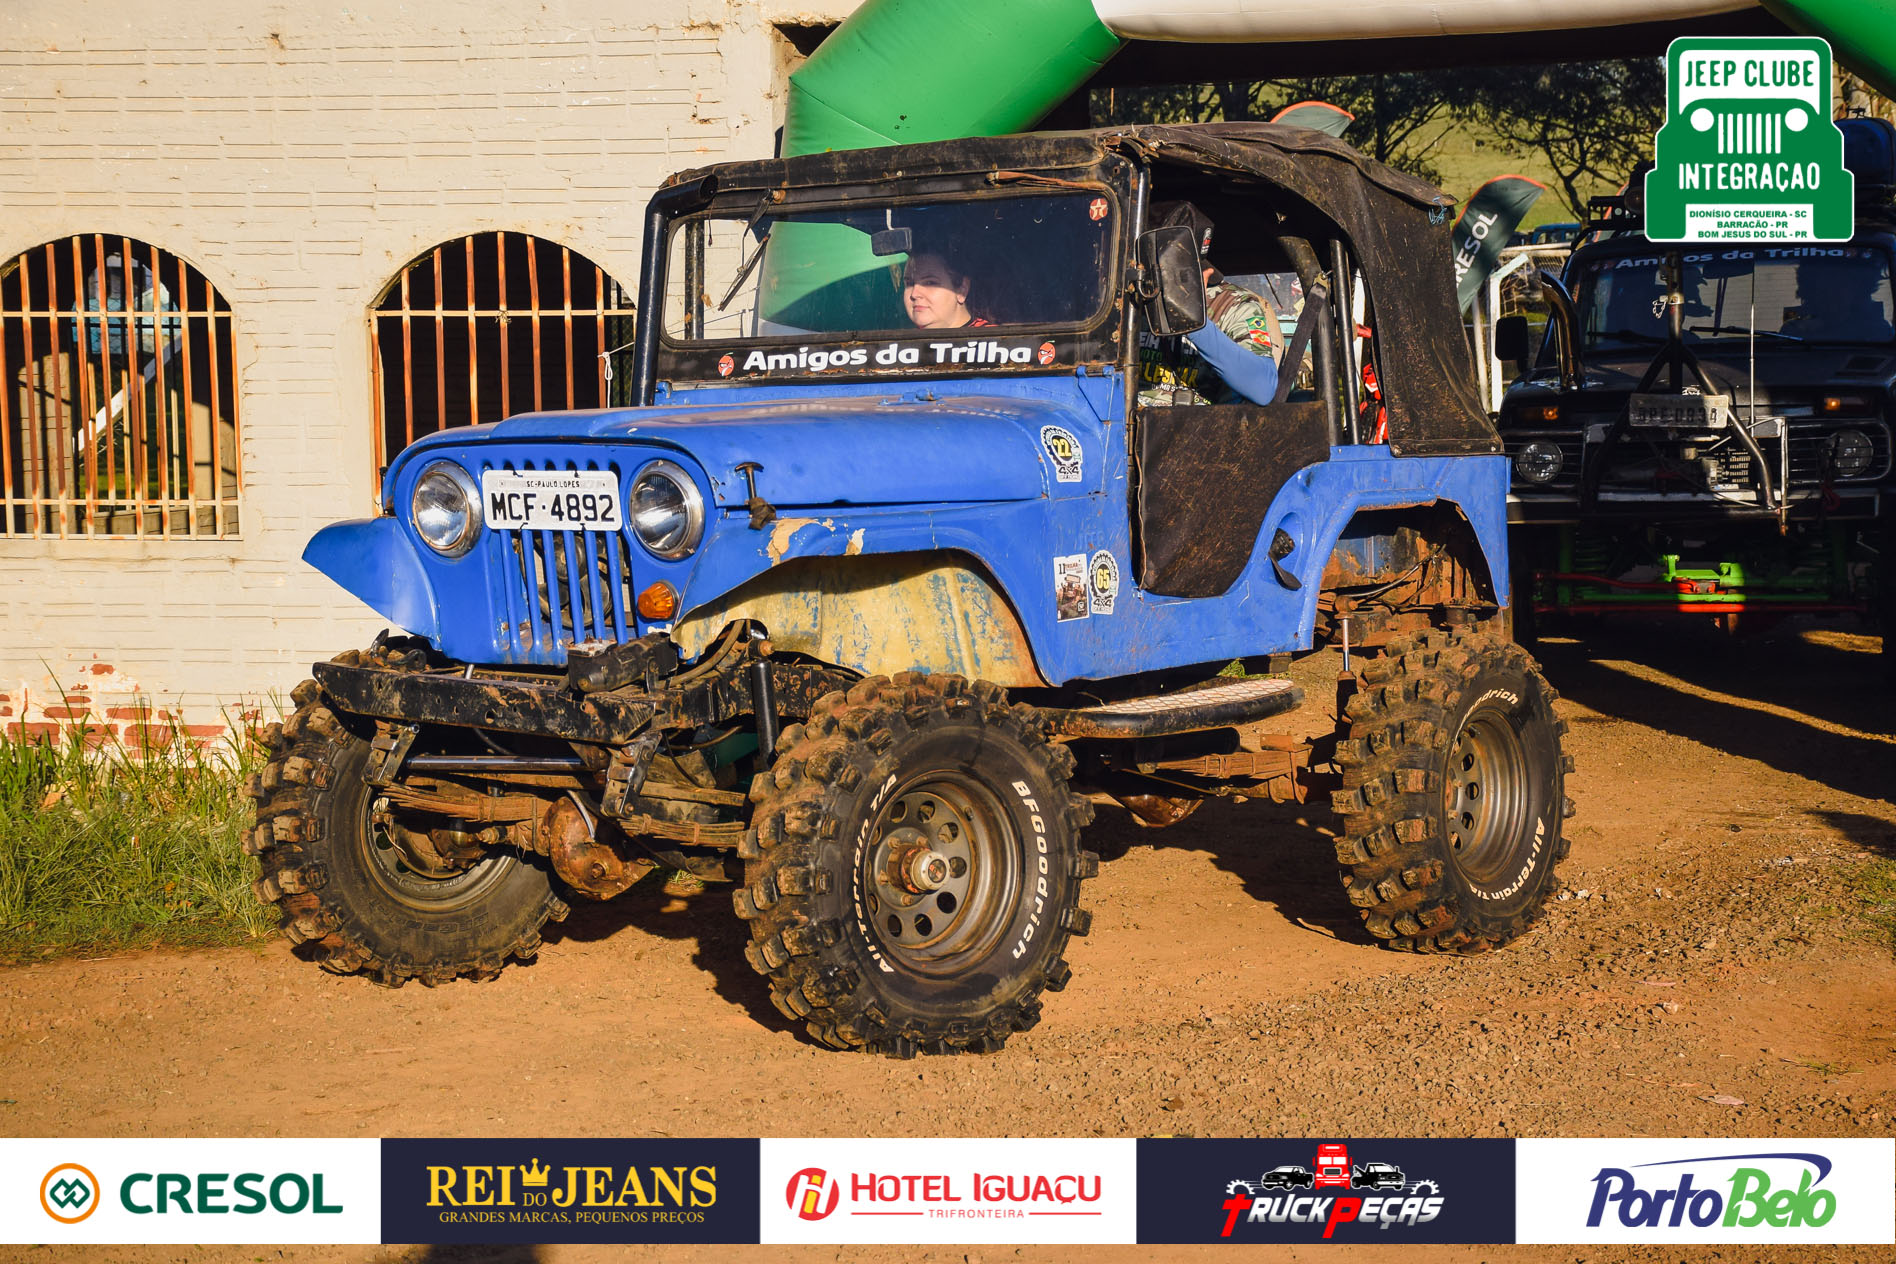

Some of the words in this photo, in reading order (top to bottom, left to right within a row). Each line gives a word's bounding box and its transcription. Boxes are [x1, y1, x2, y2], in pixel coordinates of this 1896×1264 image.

[1455, 213, 1498, 289] RESOL
[1722, 249, 1755, 261] da
[1765, 247, 1845, 258] Trilha
[743, 347, 867, 371] Amigos
[875, 343, 920, 365] da
[930, 341, 1031, 364] Trilha
[1052, 438, 1072, 457] 22
[560, 480, 580, 488] LOPES
[1096, 568, 1110, 590] 65
[1011, 780, 1048, 959] BFGoodrich
